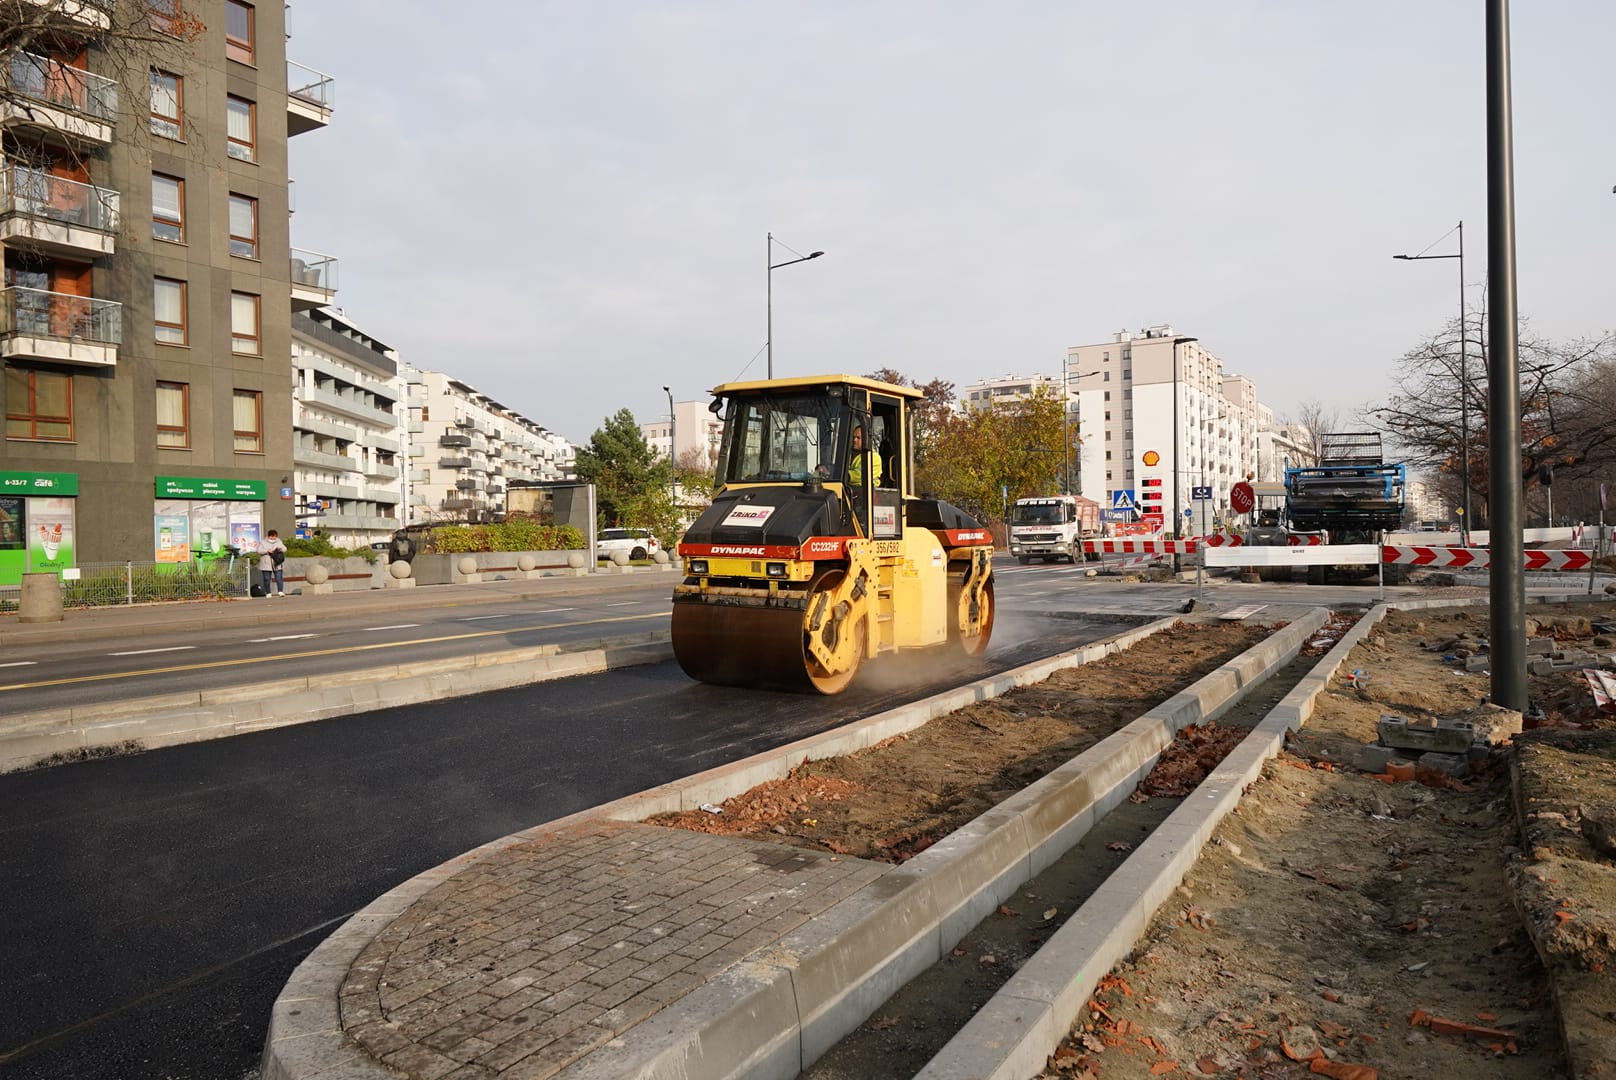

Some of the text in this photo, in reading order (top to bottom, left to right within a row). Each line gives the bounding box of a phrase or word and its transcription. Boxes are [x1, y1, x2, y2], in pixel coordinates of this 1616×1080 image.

[1233, 487, 1252, 507] STOP
[958, 532, 985, 541] DYNAPAC
[710, 546, 766, 555] DYNAPAC
[810, 541, 840, 552] CC232HF
[876, 541, 900, 554] 356/582
